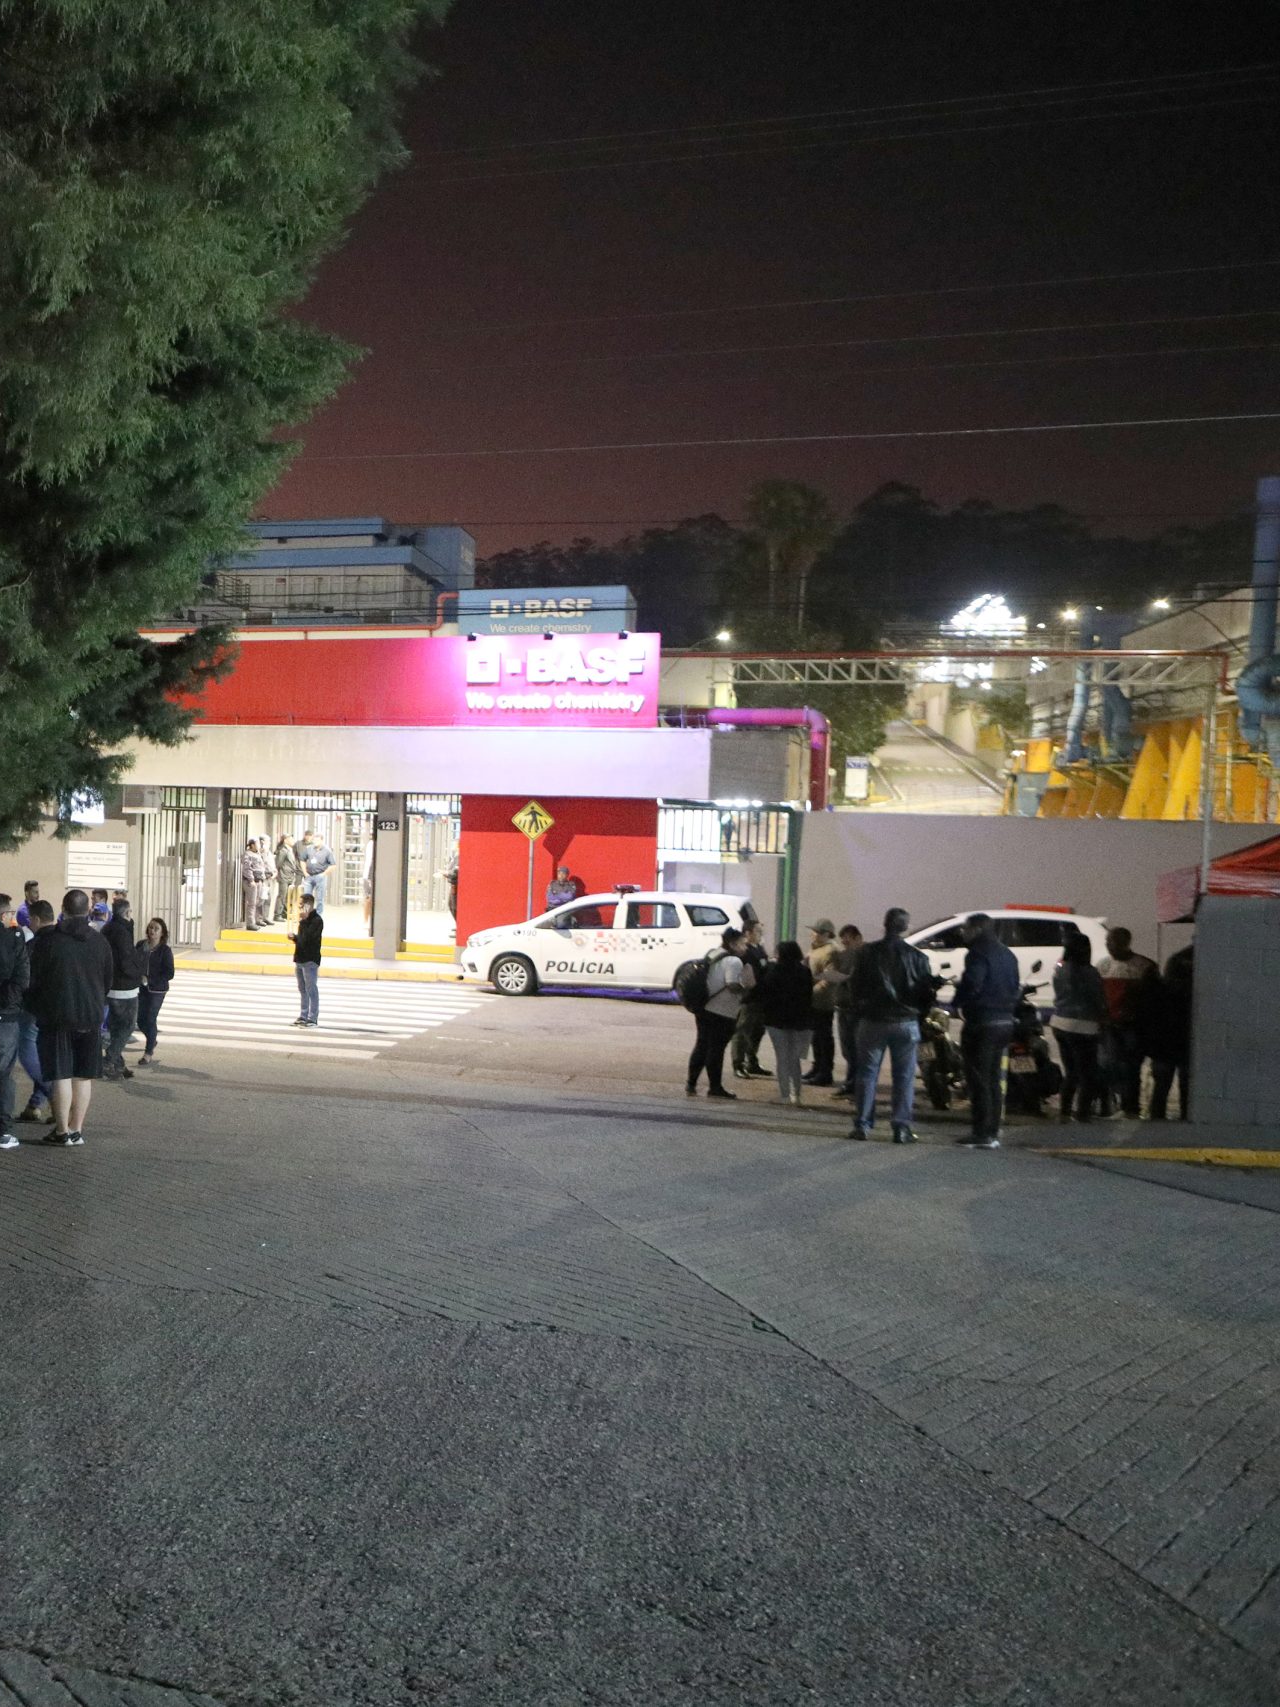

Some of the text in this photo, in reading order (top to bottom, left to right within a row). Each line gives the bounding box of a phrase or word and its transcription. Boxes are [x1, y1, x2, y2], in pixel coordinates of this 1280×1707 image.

[525, 598, 592, 618] BASF
[490, 624, 506, 633] We
[508, 624, 540, 633] create
[527, 648, 645, 684] BASF
[466, 691, 495, 711] We
[381, 821, 395, 830] 123
[545, 957, 614, 974] POLÍCIA
